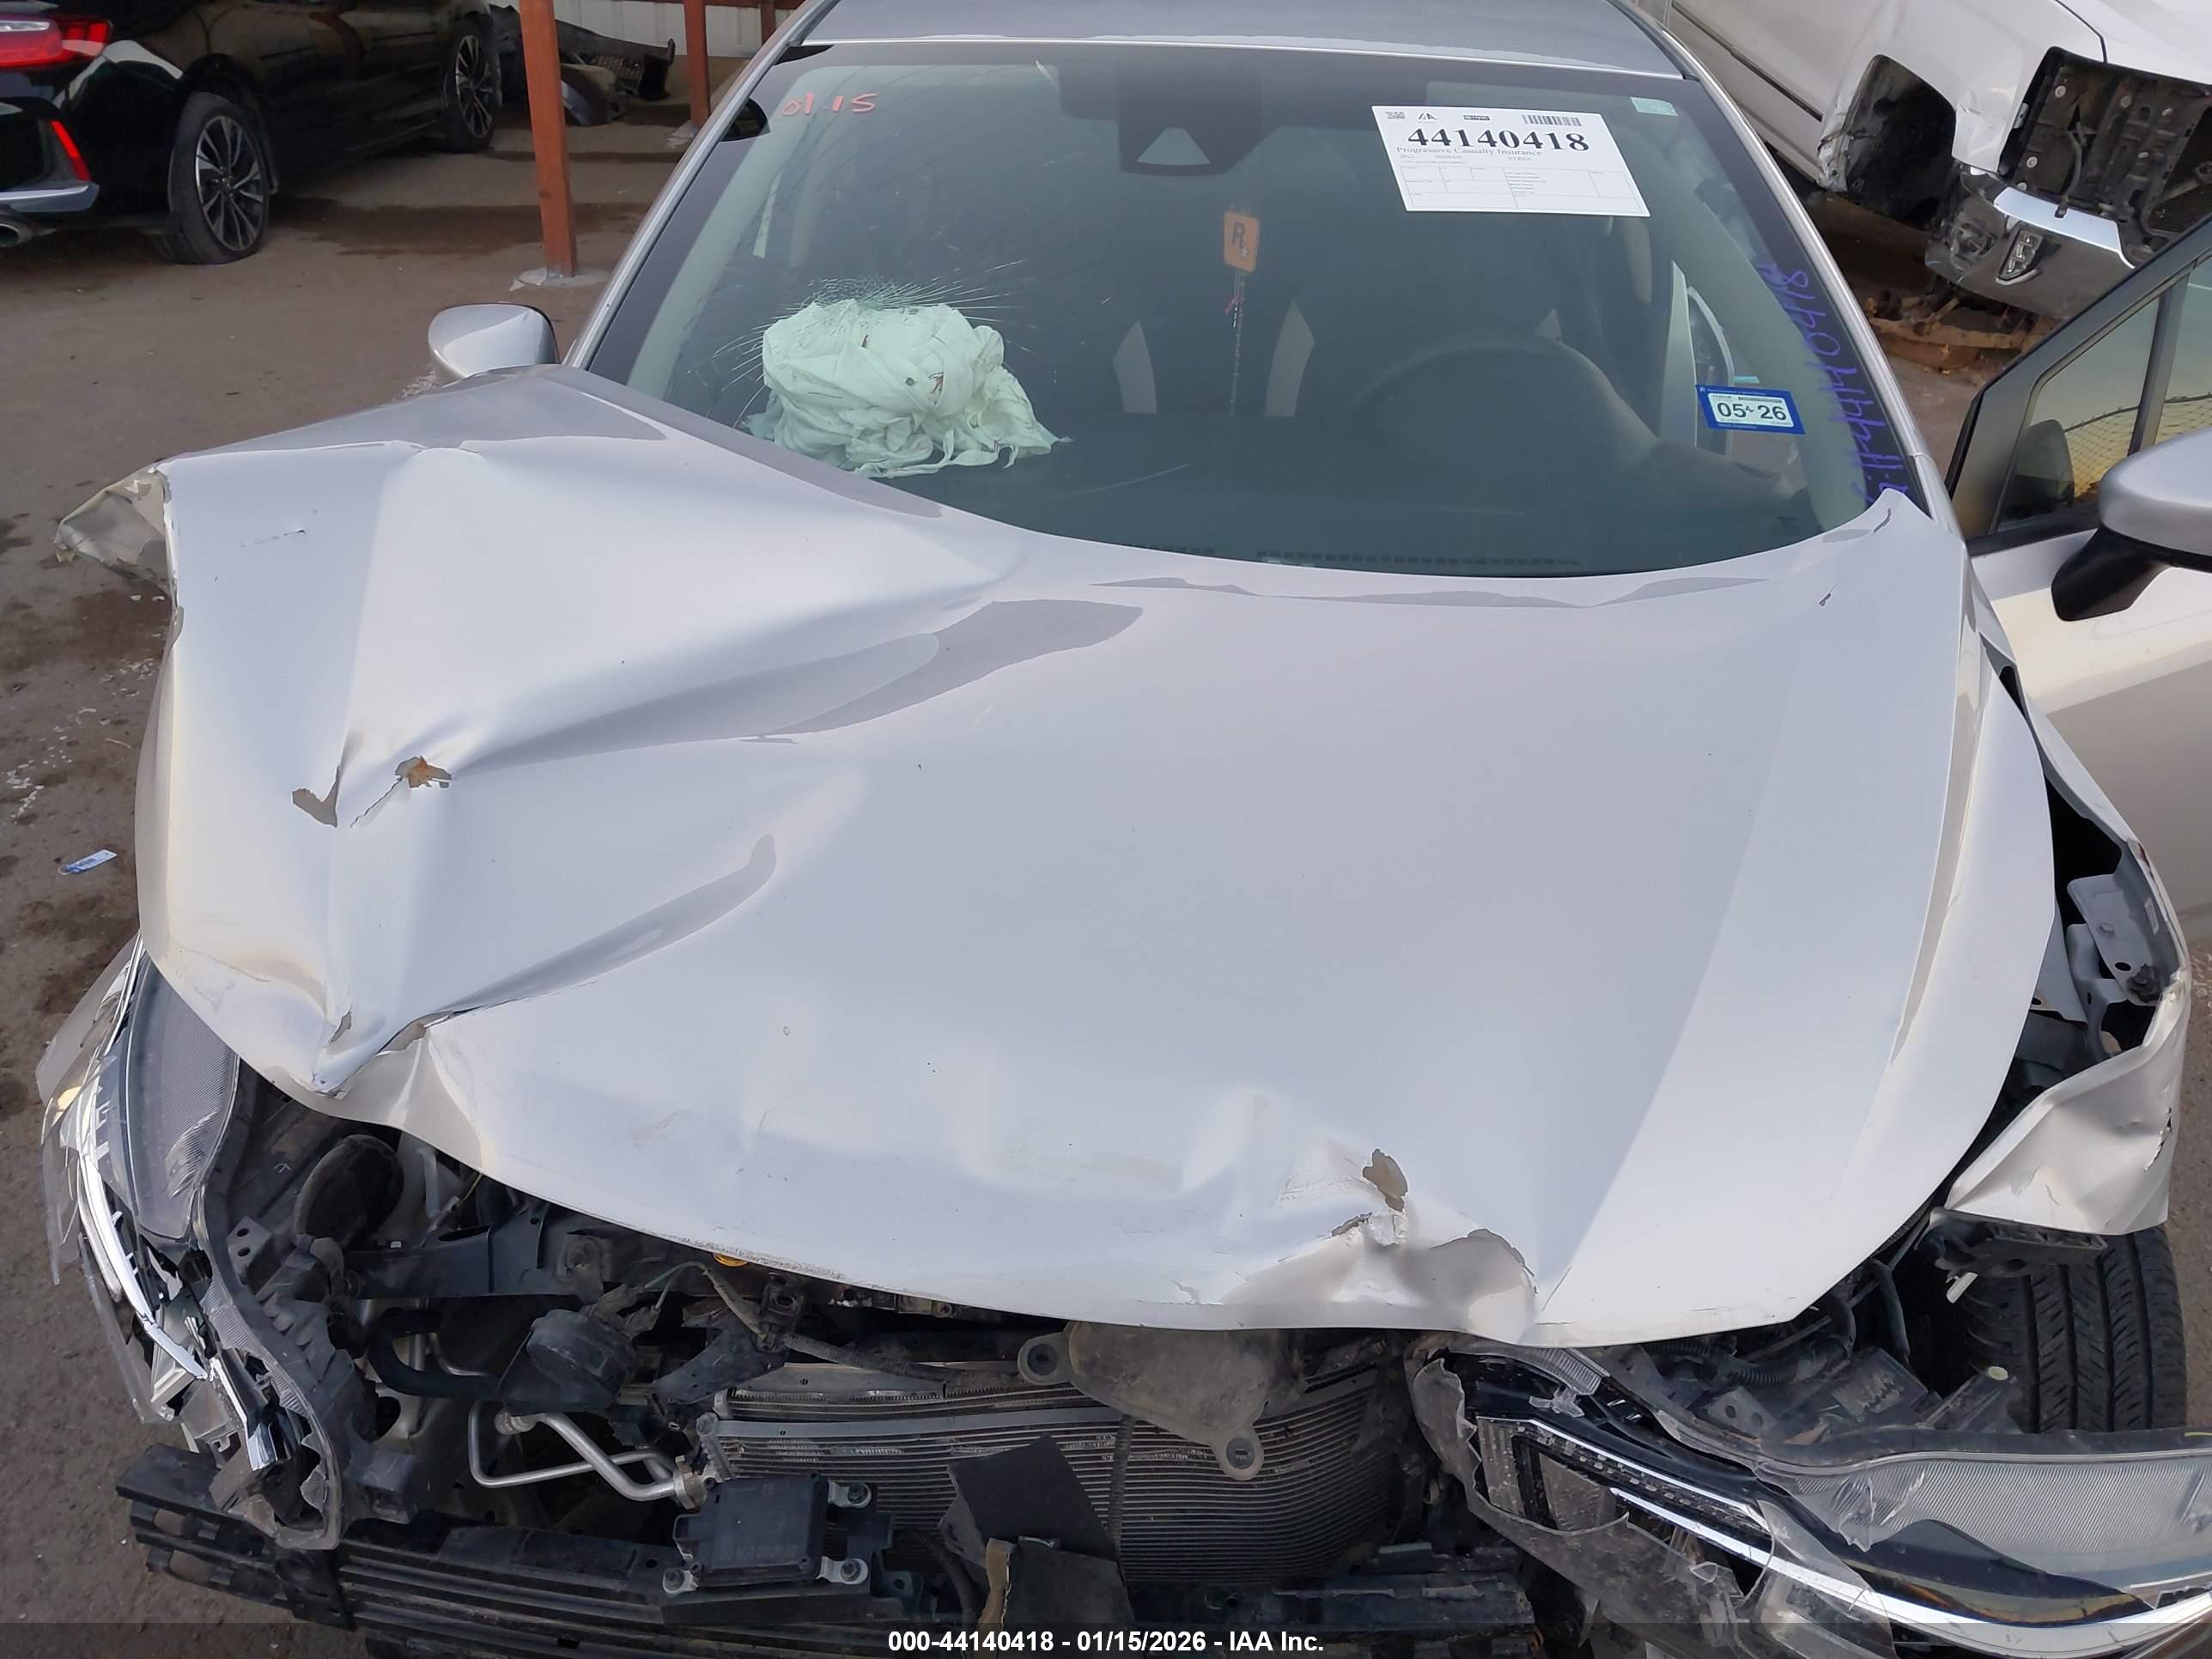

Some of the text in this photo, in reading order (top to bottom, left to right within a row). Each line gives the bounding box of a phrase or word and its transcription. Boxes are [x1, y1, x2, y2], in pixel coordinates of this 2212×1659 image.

[1408, 128, 1589, 151] 44140418
[1717, 402, 1787, 421] 05 26
